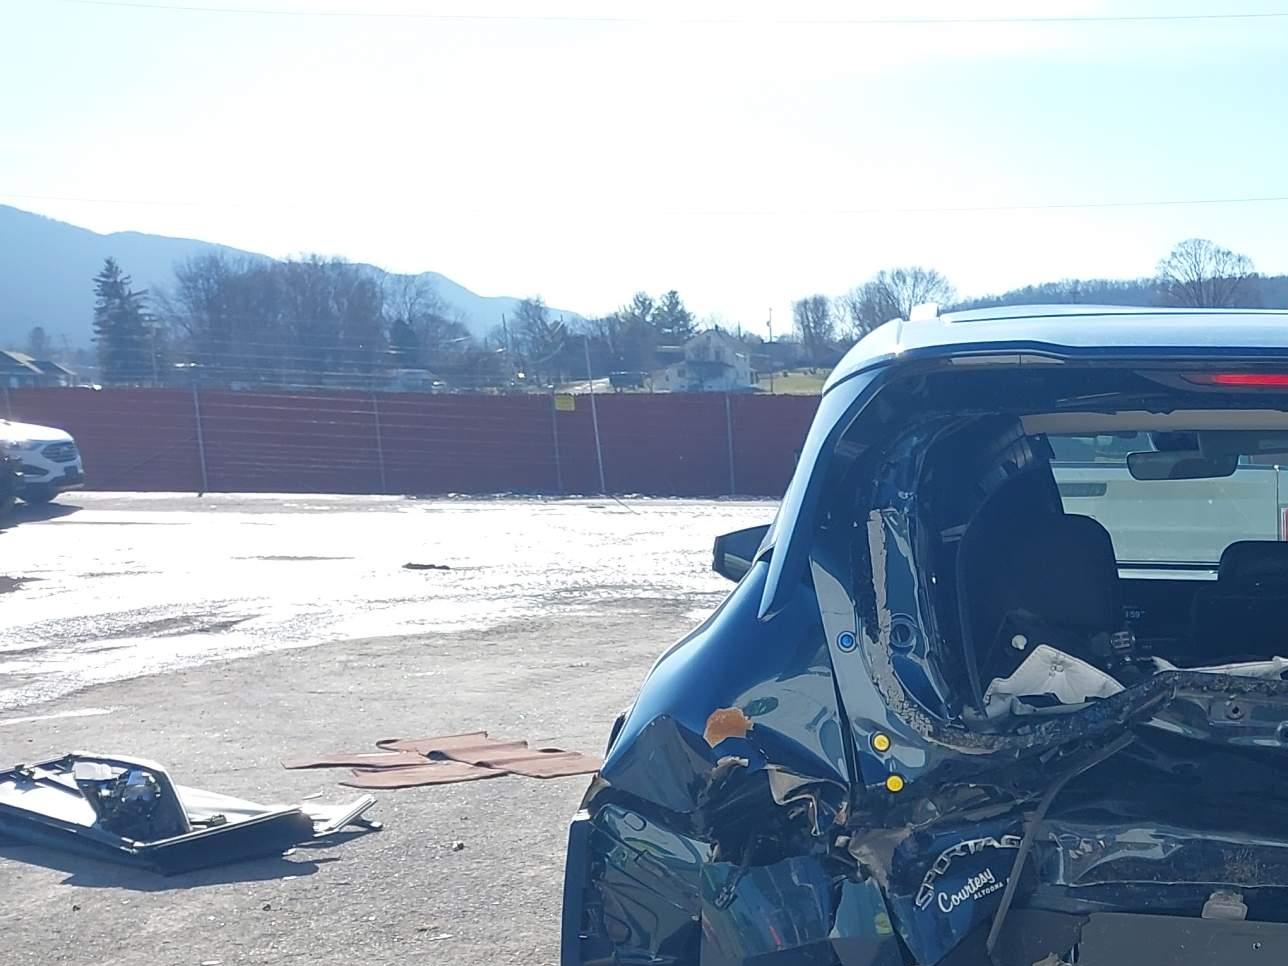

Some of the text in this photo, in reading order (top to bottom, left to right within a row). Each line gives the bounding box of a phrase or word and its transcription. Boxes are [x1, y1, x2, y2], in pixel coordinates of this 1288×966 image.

[914, 835, 1023, 911] SPORTAG
[937, 867, 996, 912] Courtesy
[973, 881, 1004, 900] ALTOONA
